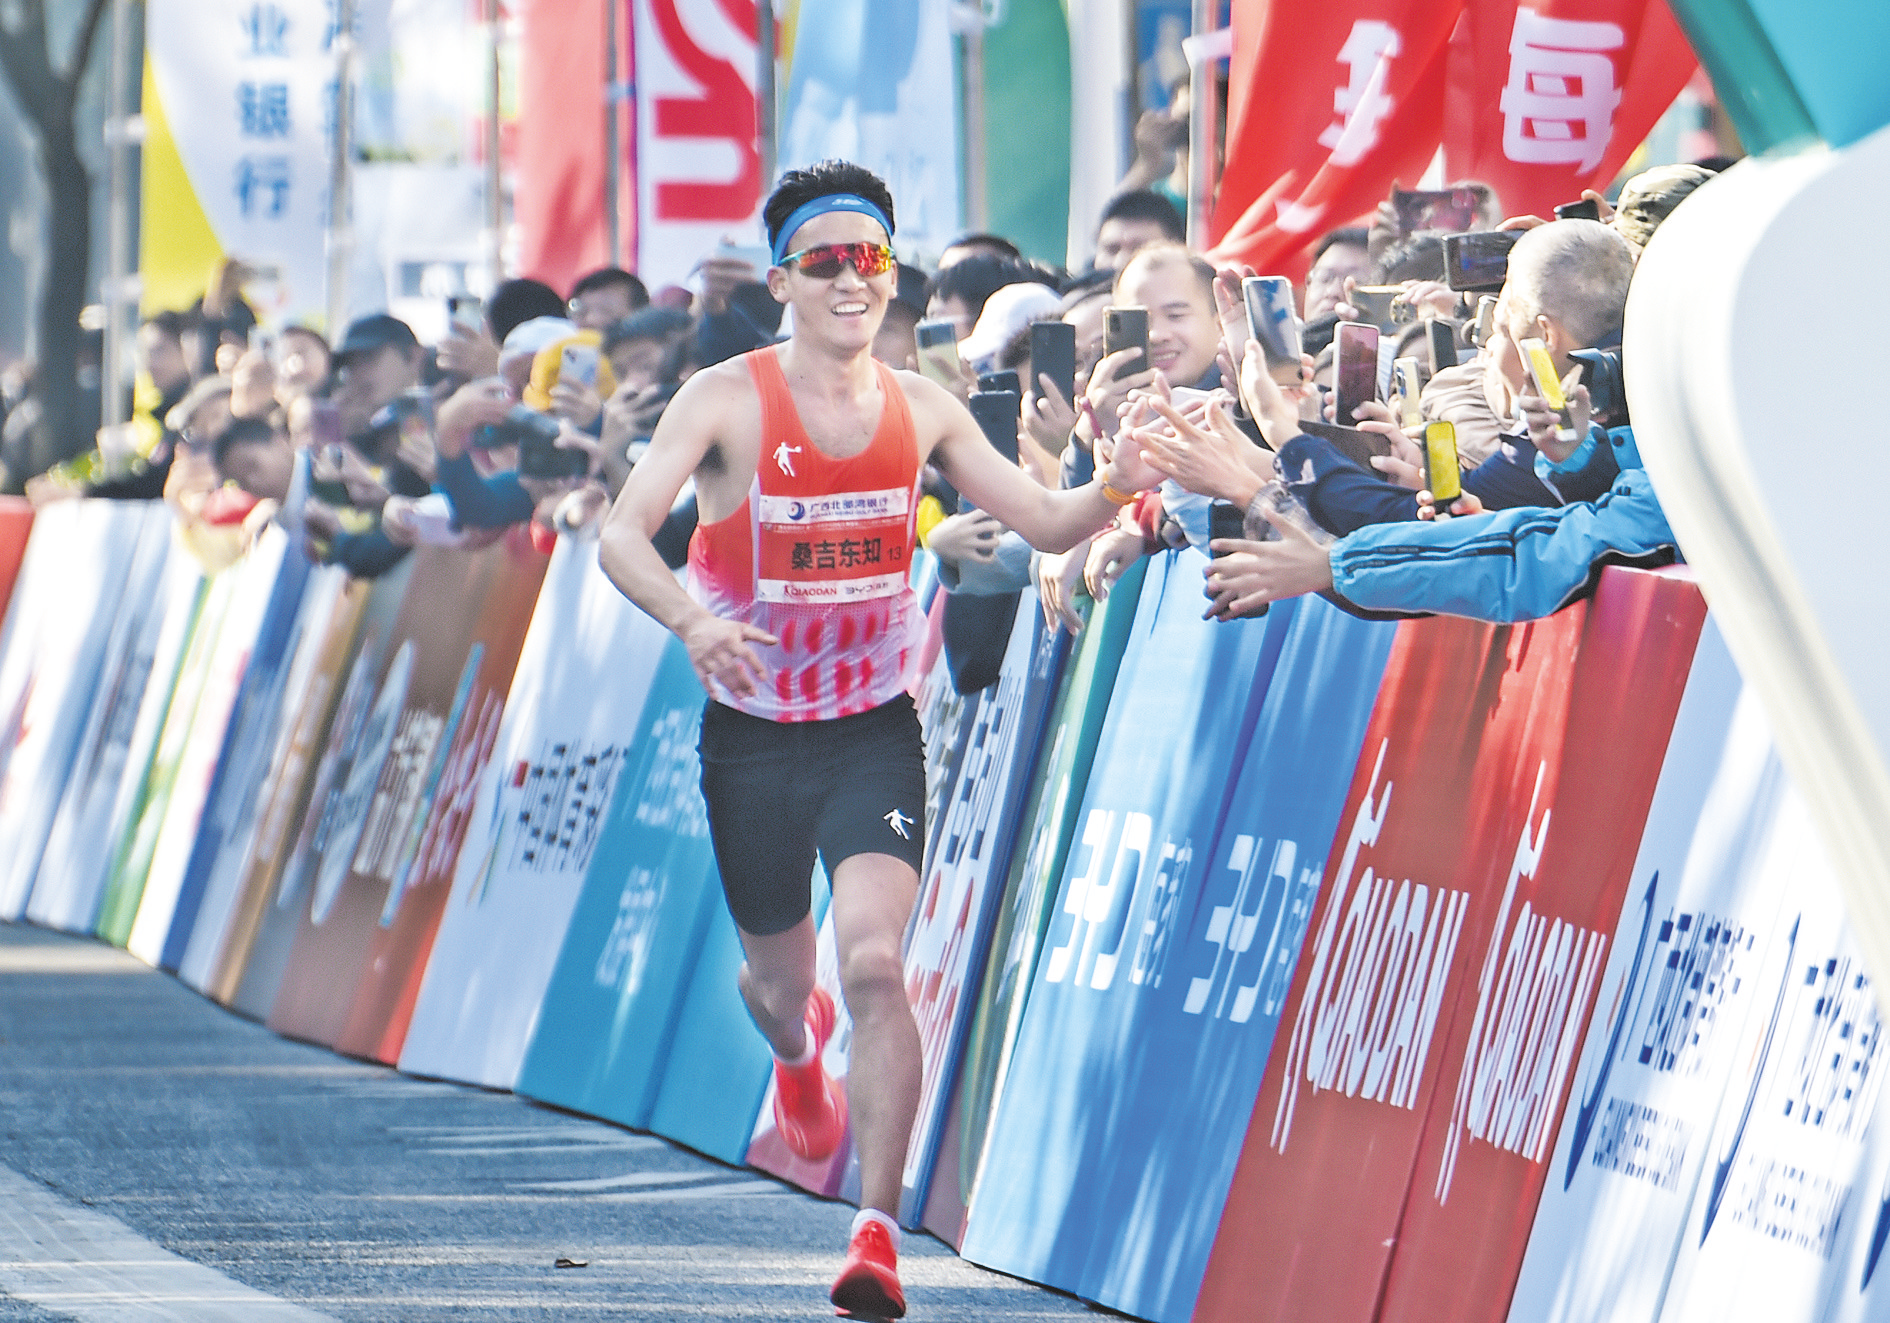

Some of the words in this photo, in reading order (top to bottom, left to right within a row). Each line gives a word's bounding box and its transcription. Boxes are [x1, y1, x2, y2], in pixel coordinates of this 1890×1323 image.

[791, 537, 882, 571] 桑吉东知
[809, 497, 889, 513] 广西北部湾银行
[887, 546, 902, 562] 13
[791, 587, 838, 597] QIAODAN
[508, 738, 629, 873] 中国体育彩
[1045, 808, 1153, 991] BYD
[1182, 834, 1298, 1023] BYD
[1306, 865, 1470, 1110] QIAODAN
[1466, 899, 1607, 1164] QIAODAN
[1621, 906, 1755, 1081] 广西北部湾银行
